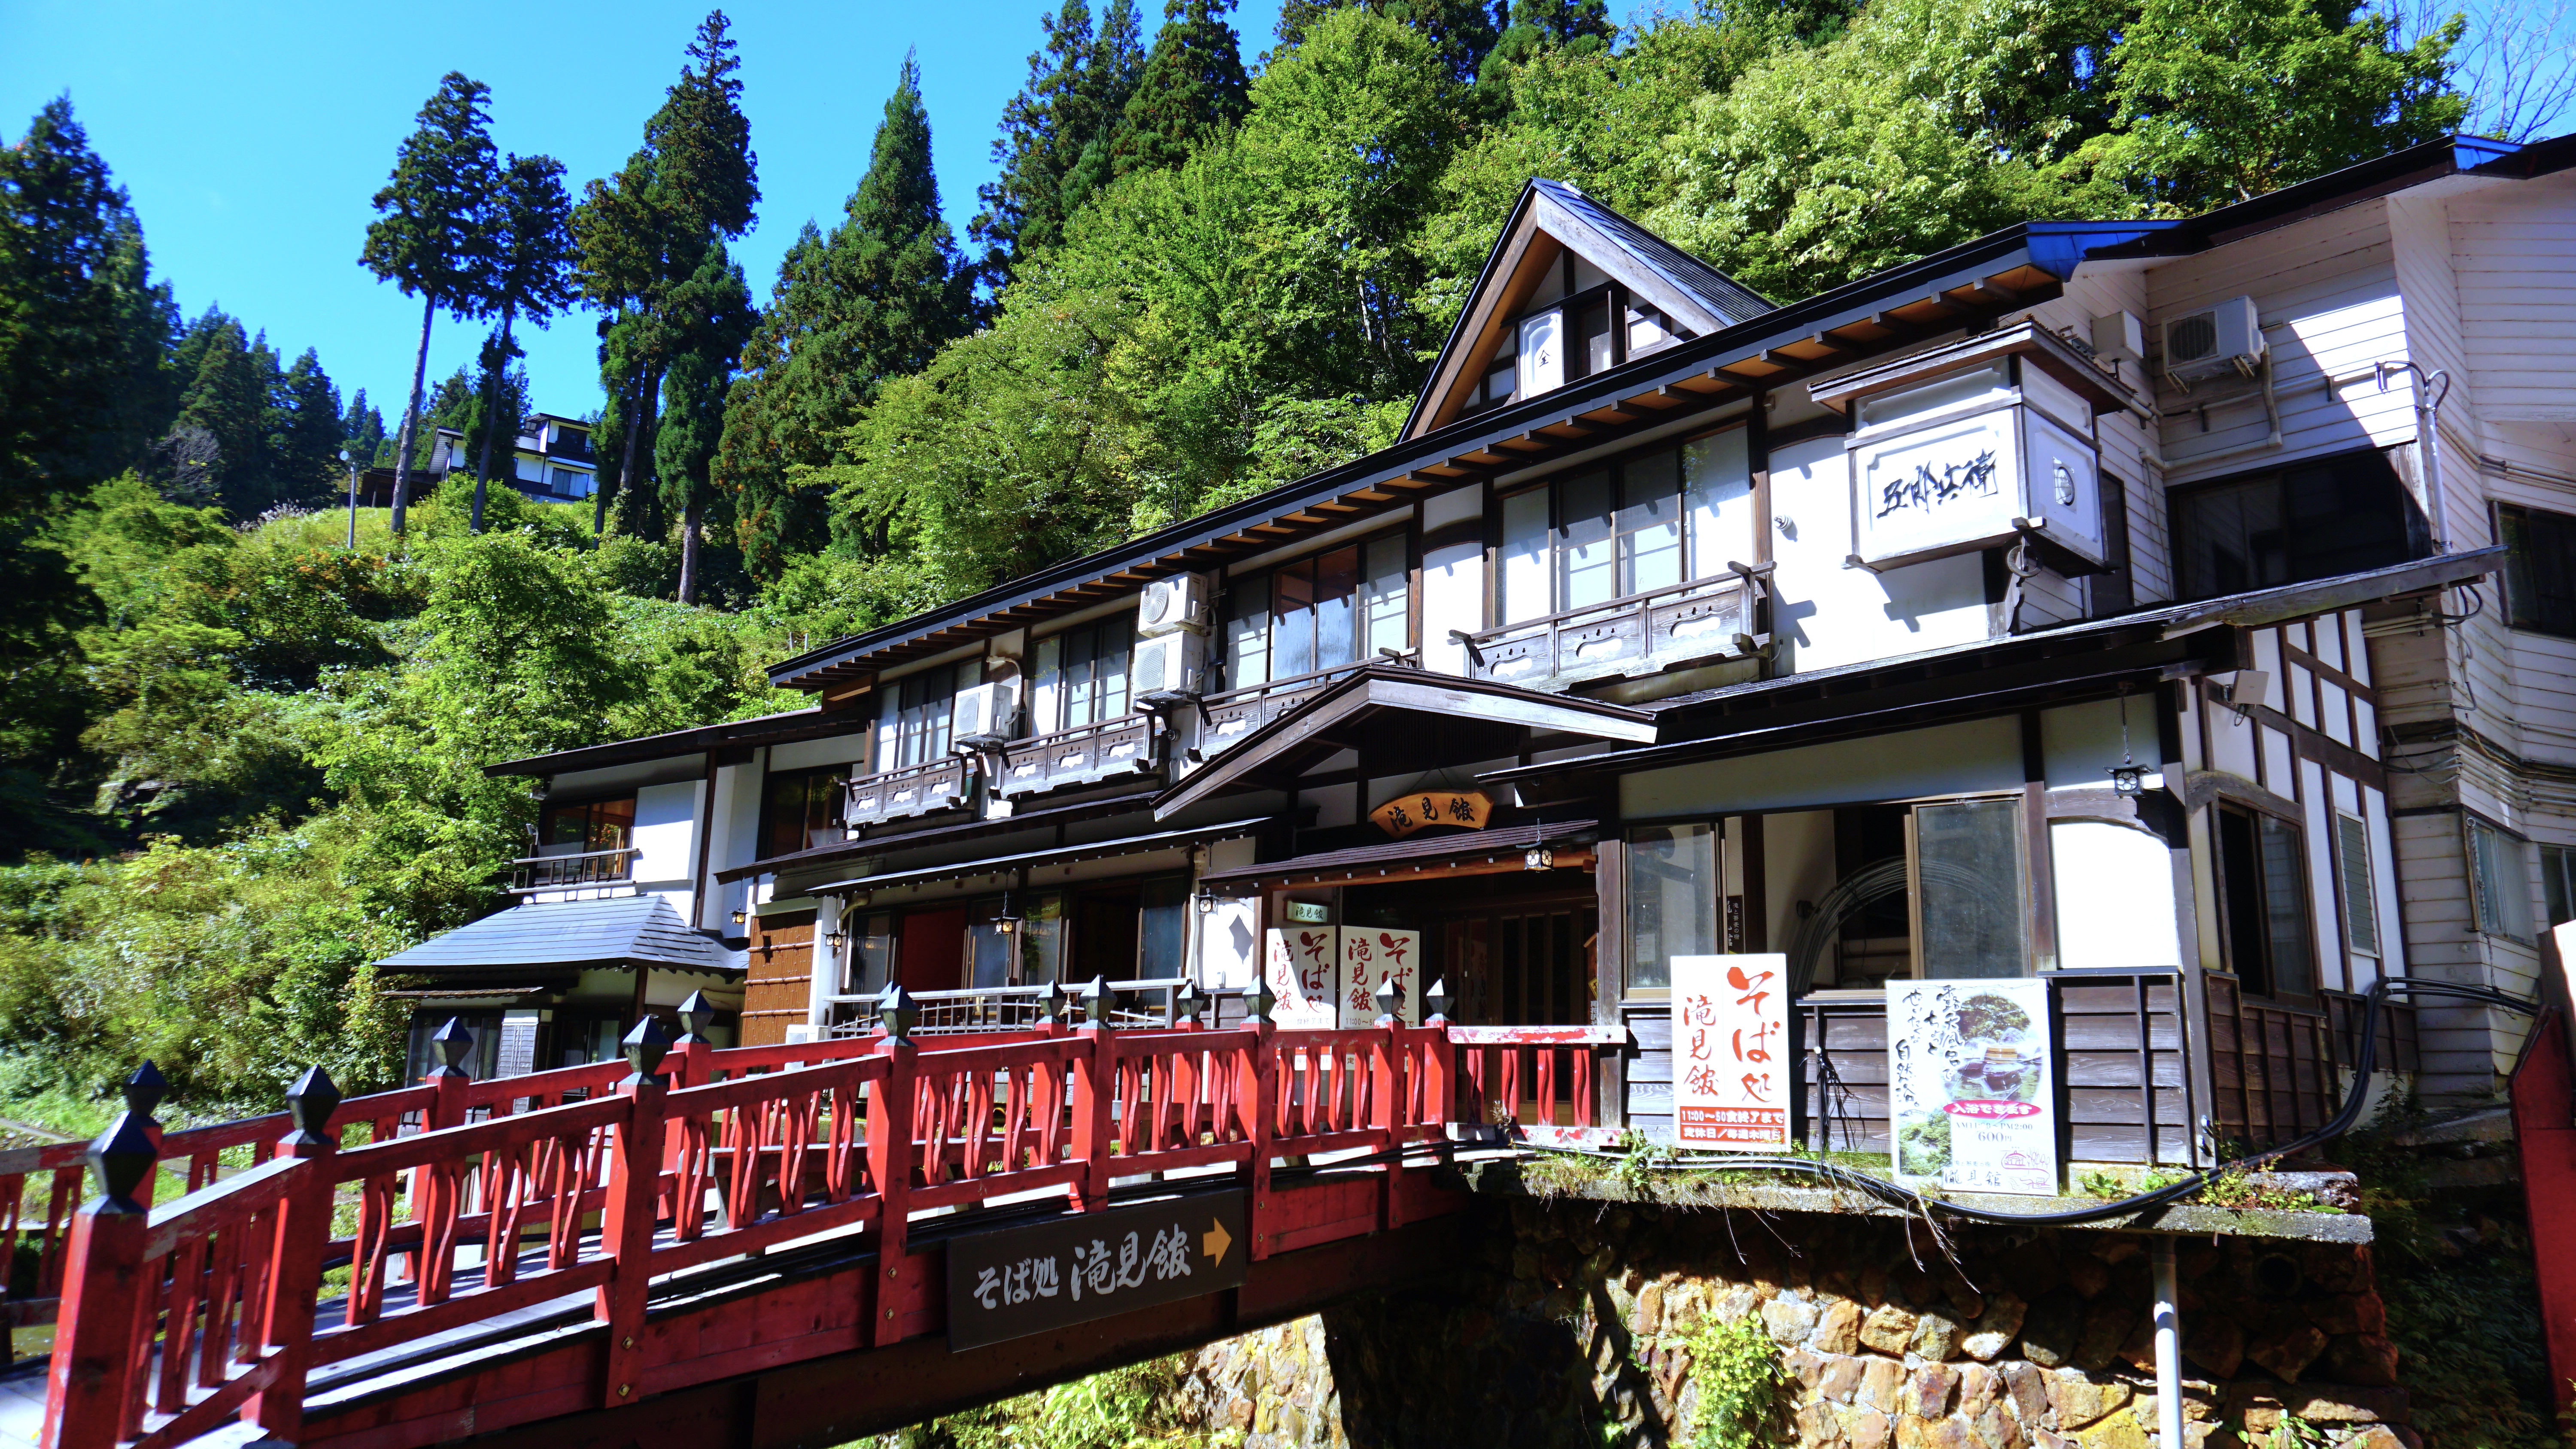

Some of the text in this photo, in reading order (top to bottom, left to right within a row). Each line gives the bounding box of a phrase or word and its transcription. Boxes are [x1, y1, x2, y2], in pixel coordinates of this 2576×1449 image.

[1300, 931, 1330, 1013] そば処
[1379, 933, 1413, 1016] そば
[1727, 967, 1781, 1102] そば処
[1953, 1103, 2032, 1115] 入浴できます
[1978, 1131, 2012, 1142] 600円
[973, 1256, 1059, 1310] そば処
